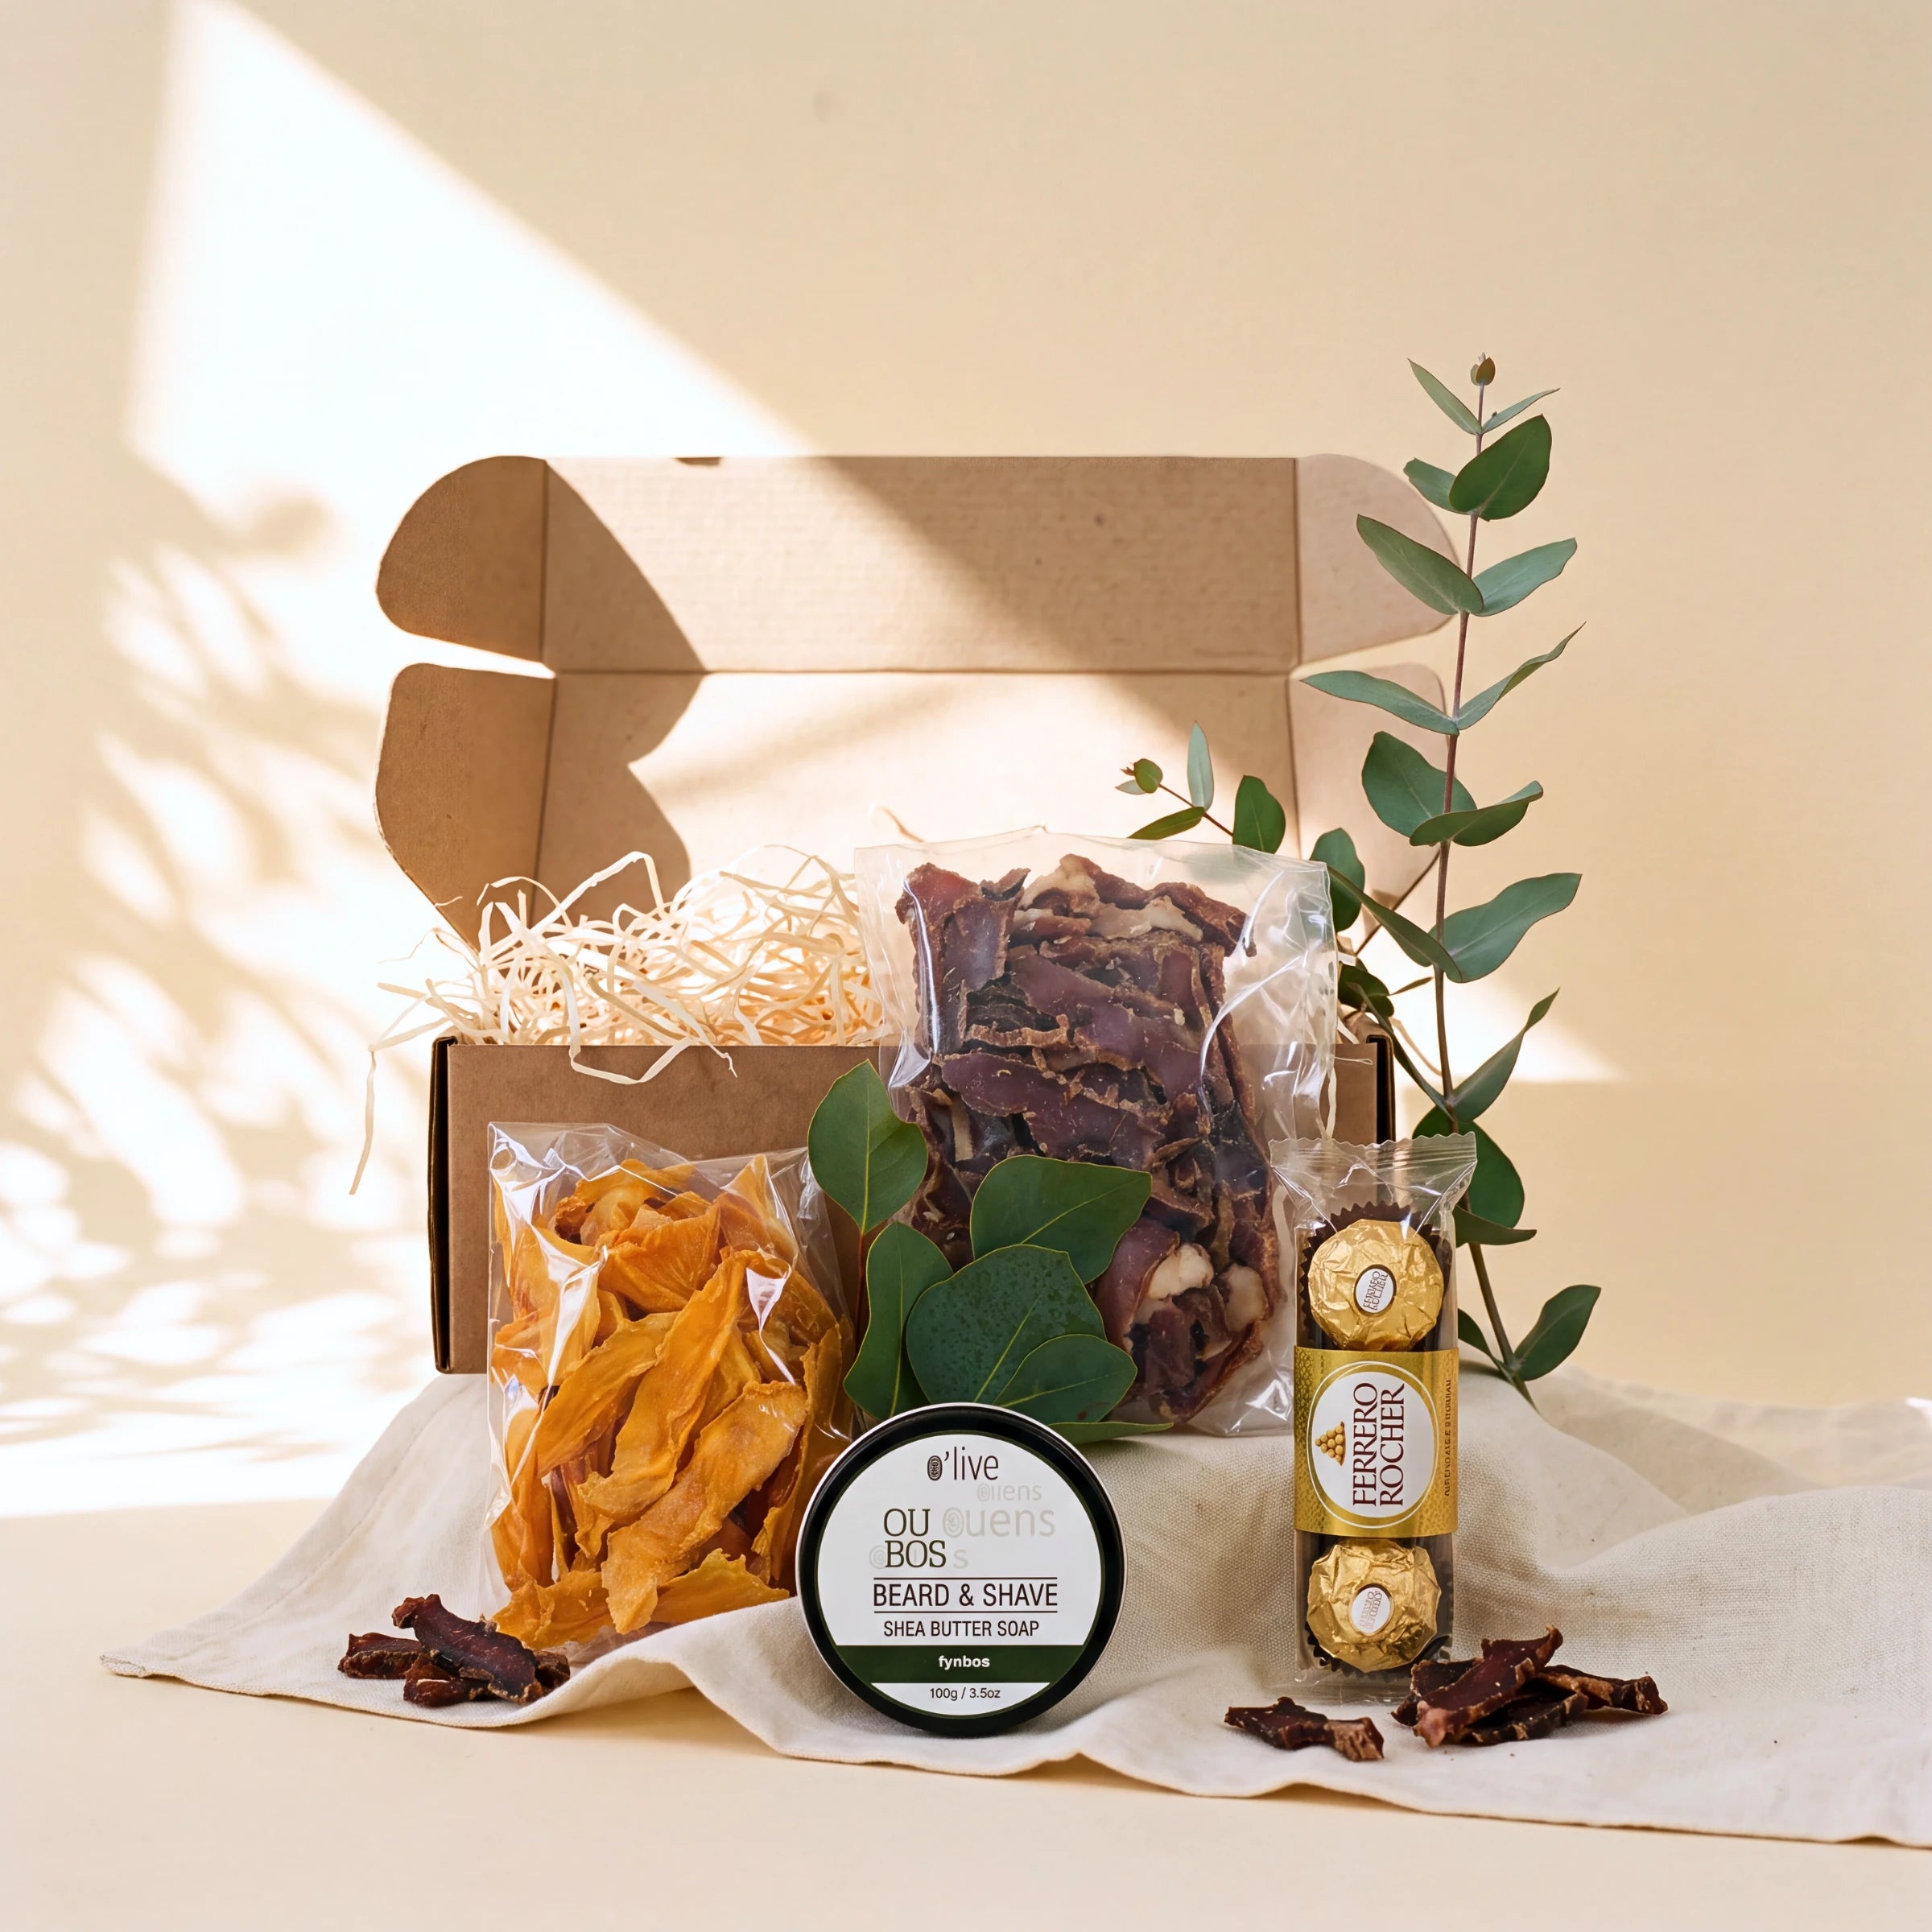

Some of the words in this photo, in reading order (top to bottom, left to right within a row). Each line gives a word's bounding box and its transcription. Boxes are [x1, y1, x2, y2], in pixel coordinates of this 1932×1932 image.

[1353, 1382, 1378, 1507] FERRERO
[1380, 1382, 1406, 1507] ROCHER
[884, 1508, 931, 1537] OU
[885, 1539, 947, 1568] BOS
[873, 1583, 950, 1607] BEARD
[959, 1583, 974, 1607] &
[983, 1583, 1058, 1607] SHAVE
[884, 1620, 926, 1637] SHEA
[931, 1620, 993, 1637] BUTTER
[997, 1620, 1039, 1637] SOAP
[938, 1655, 991, 1671] fynbos
[930, 1687, 958, 1702] 100g
[960, 1687, 967, 1700] /
[969, 1687, 1001, 1699] 3.5oz
